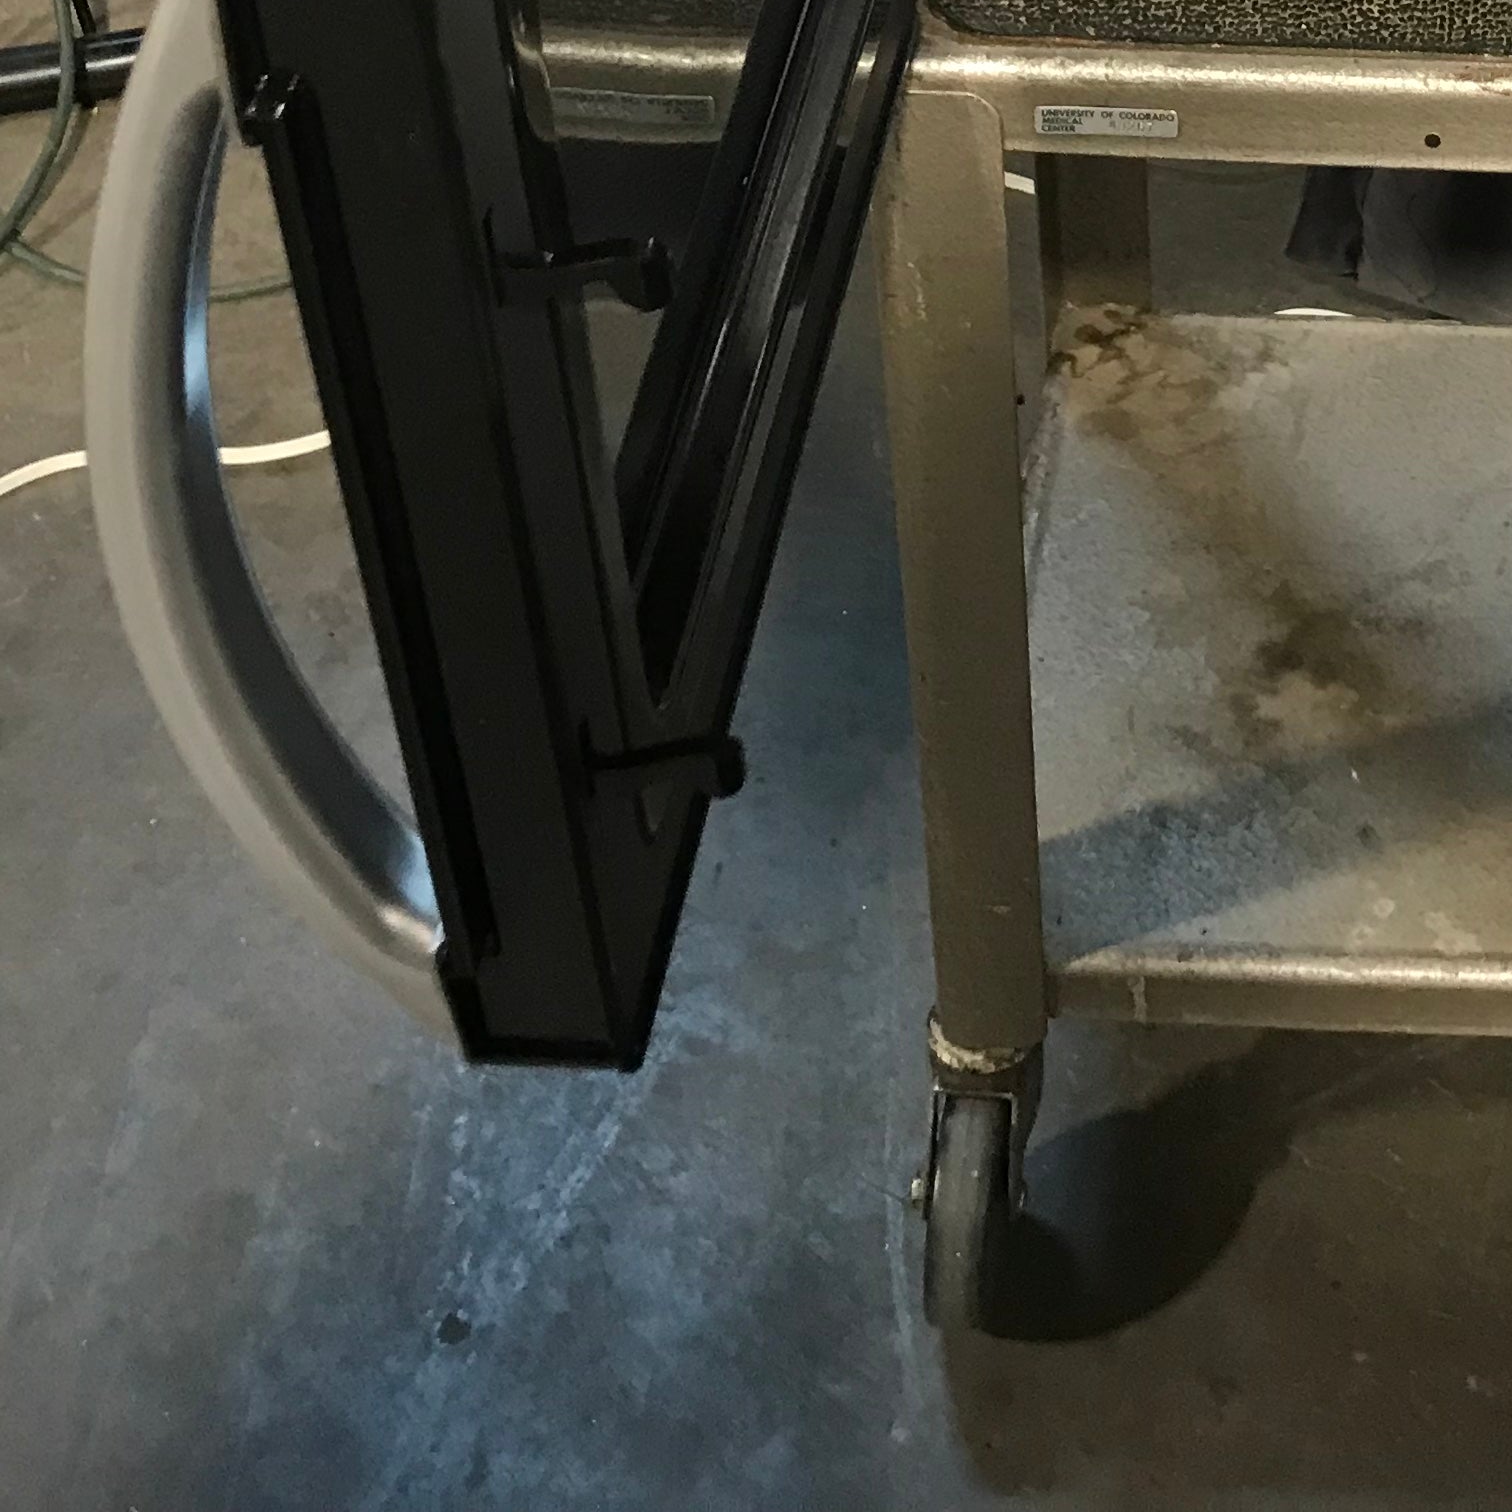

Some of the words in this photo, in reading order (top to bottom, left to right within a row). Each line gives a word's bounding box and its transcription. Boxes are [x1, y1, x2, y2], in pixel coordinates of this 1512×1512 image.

[1041, 109, 1095, 118] UNIVERSITY
[1101, 111, 1114, 119] OF
[1119, 111, 1175, 122] COLORADO
[1041, 124, 1076, 132] CENTER
